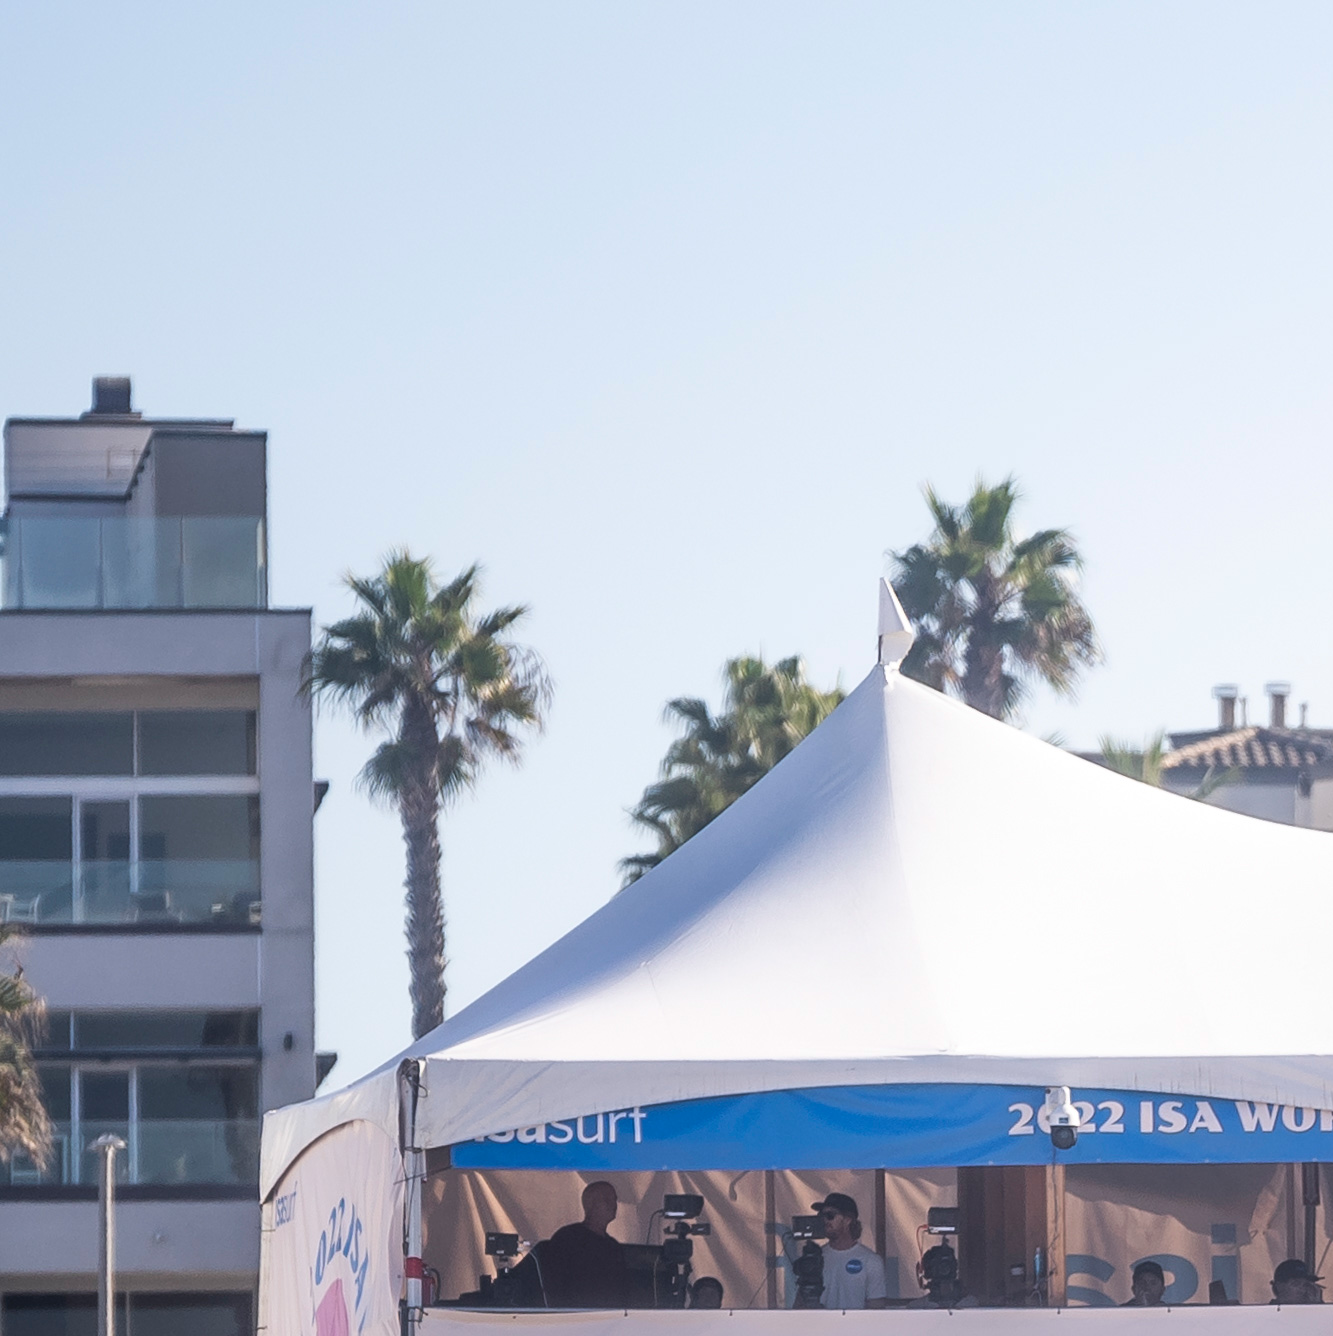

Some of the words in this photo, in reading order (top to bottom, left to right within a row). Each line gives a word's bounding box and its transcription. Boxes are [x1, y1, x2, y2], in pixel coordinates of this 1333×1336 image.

[475, 1106, 647, 1144] asurf
[1008, 1100, 1125, 1136] 222
[1139, 1101, 1222, 1135] ISA
